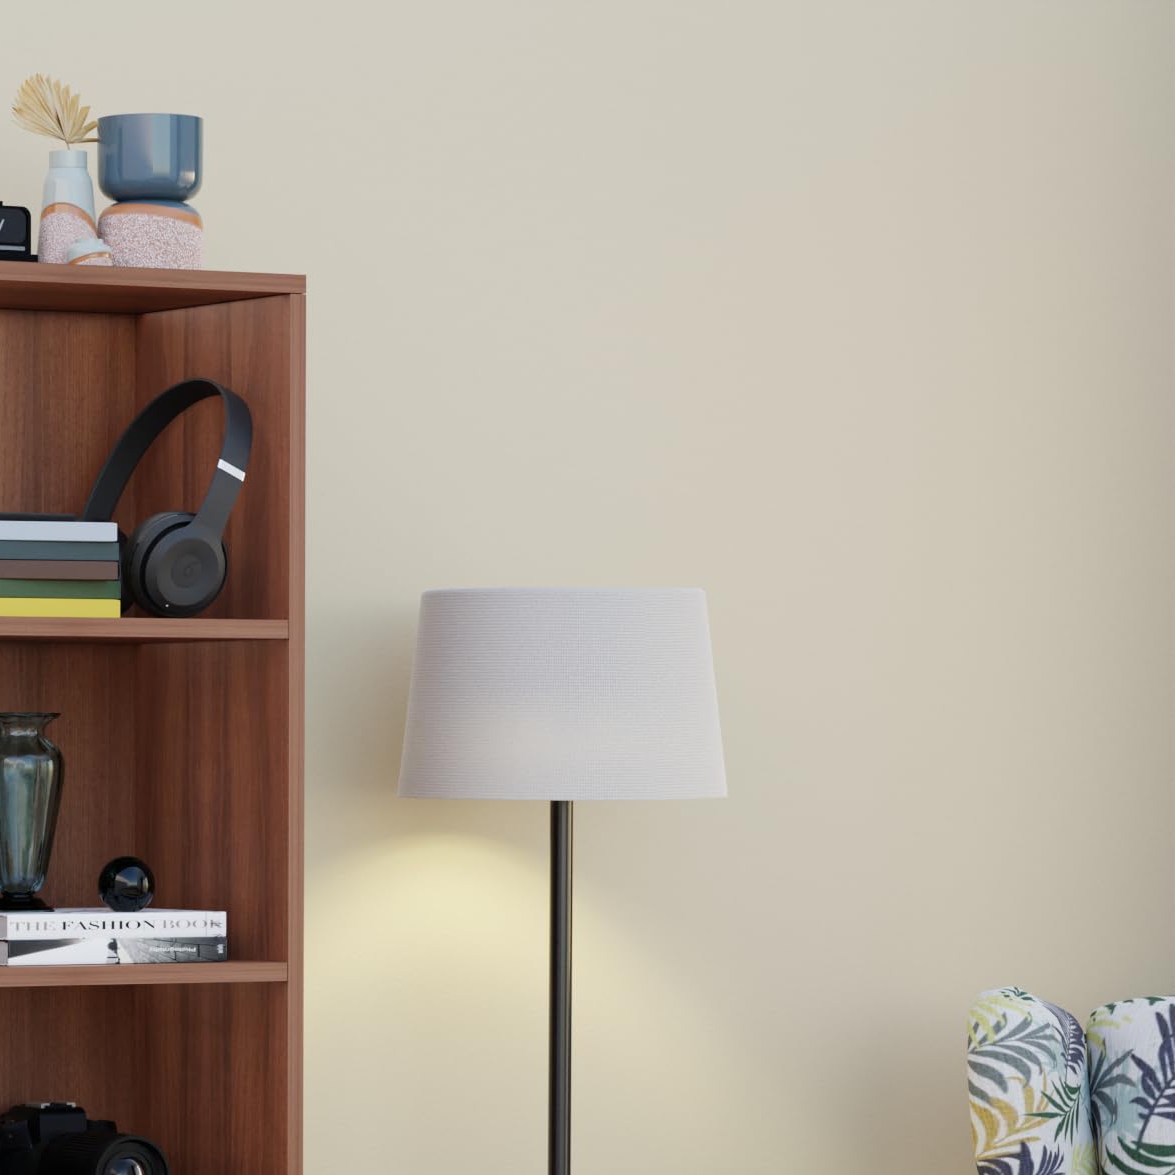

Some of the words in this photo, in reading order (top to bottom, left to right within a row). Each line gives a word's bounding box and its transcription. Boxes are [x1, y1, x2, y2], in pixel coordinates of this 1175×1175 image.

[9, 921, 56, 932] THE
[62, 919, 155, 930] FASHION
[162, 919, 223, 929] BOOK
